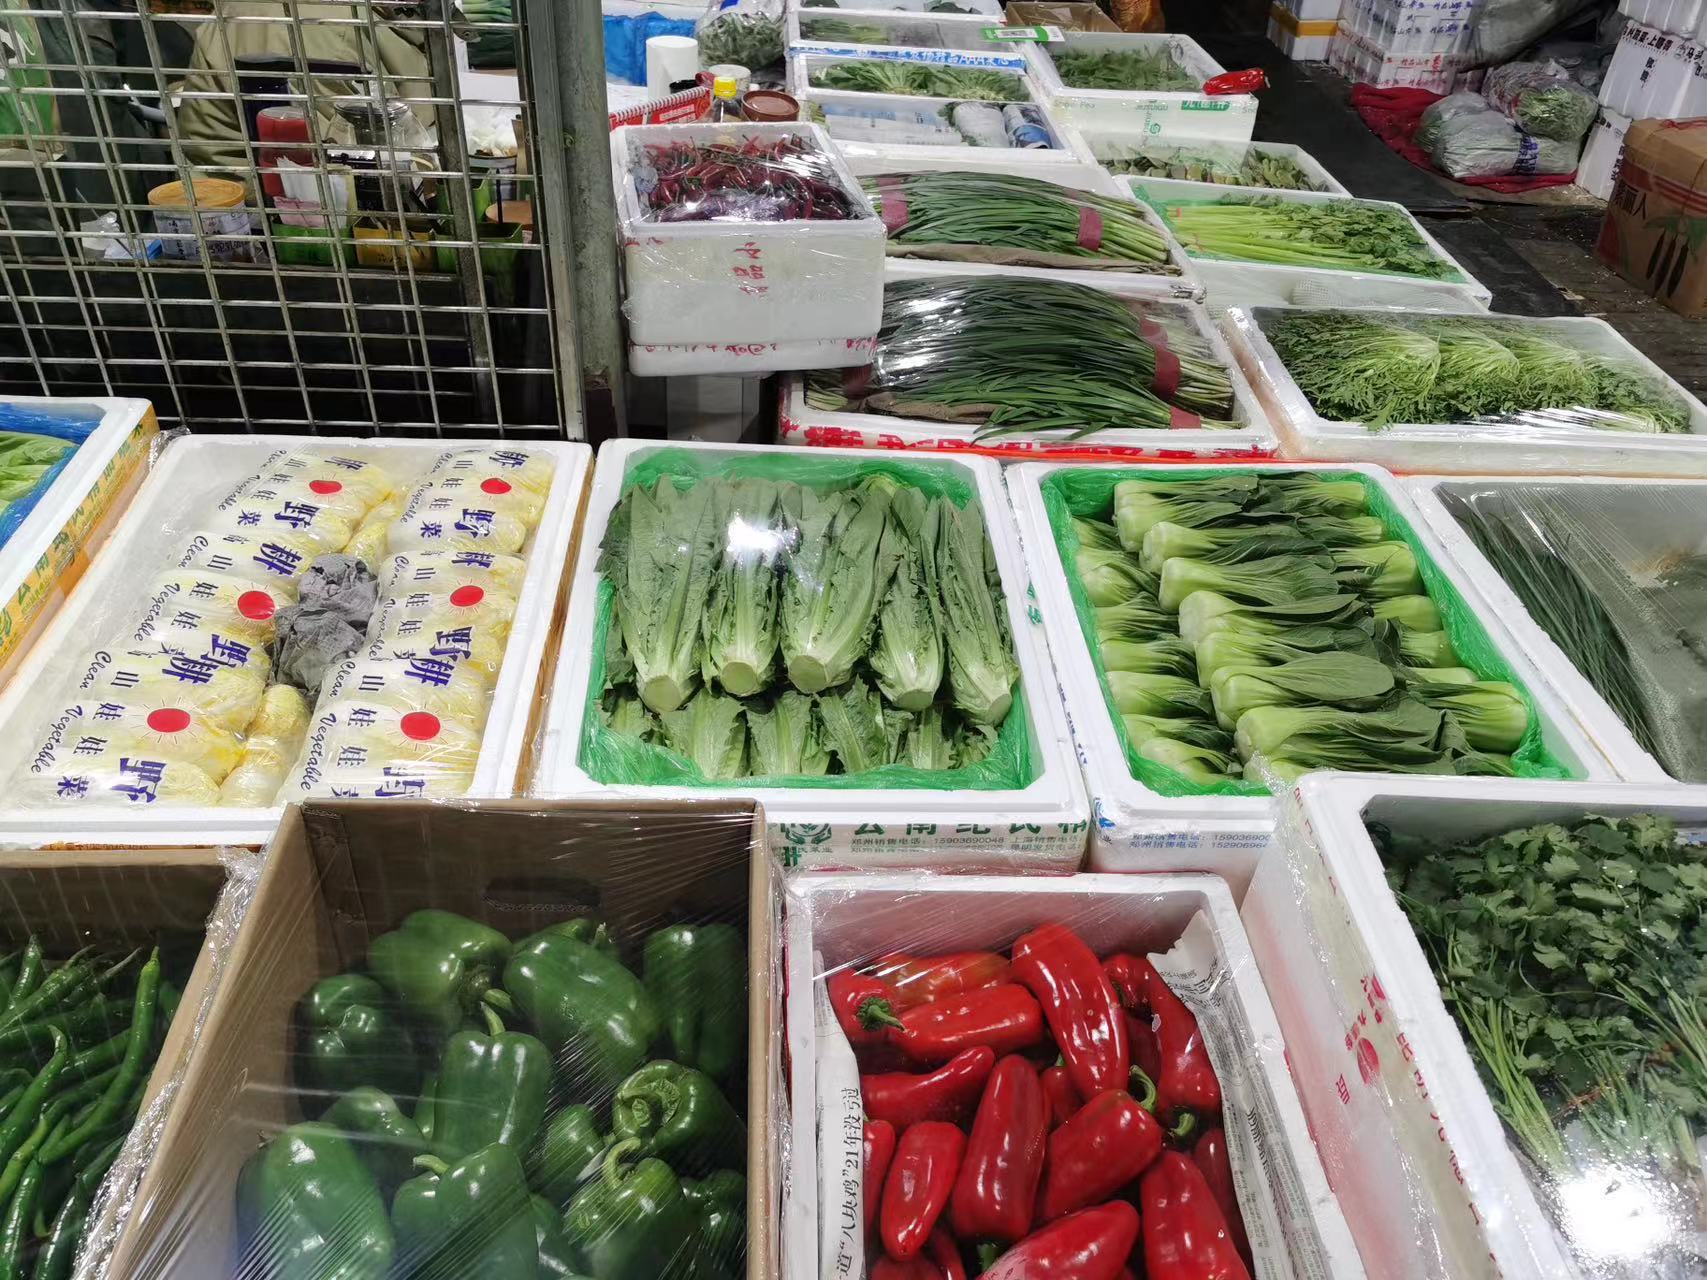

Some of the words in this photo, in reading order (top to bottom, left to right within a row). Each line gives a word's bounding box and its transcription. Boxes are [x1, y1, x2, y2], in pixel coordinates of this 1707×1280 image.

[177, 535, 209, 568] Clean
[253, 542, 303, 576] 耕
[134, 583, 181, 642] Vegetable
[200, 633, 252, 669] 野
[429, 626, 473, 662] 野
[80, 651, 112, 690] Clean
[162, 656, 220, 684] 耕
[329, 660, 357, 698] Clean
[403, 658, 456, 688] 耕
[31, 705, 84, 775] Vegetable
[300, 712, 337, 791] Vegetable
[110, 757, 168, 803] 野
